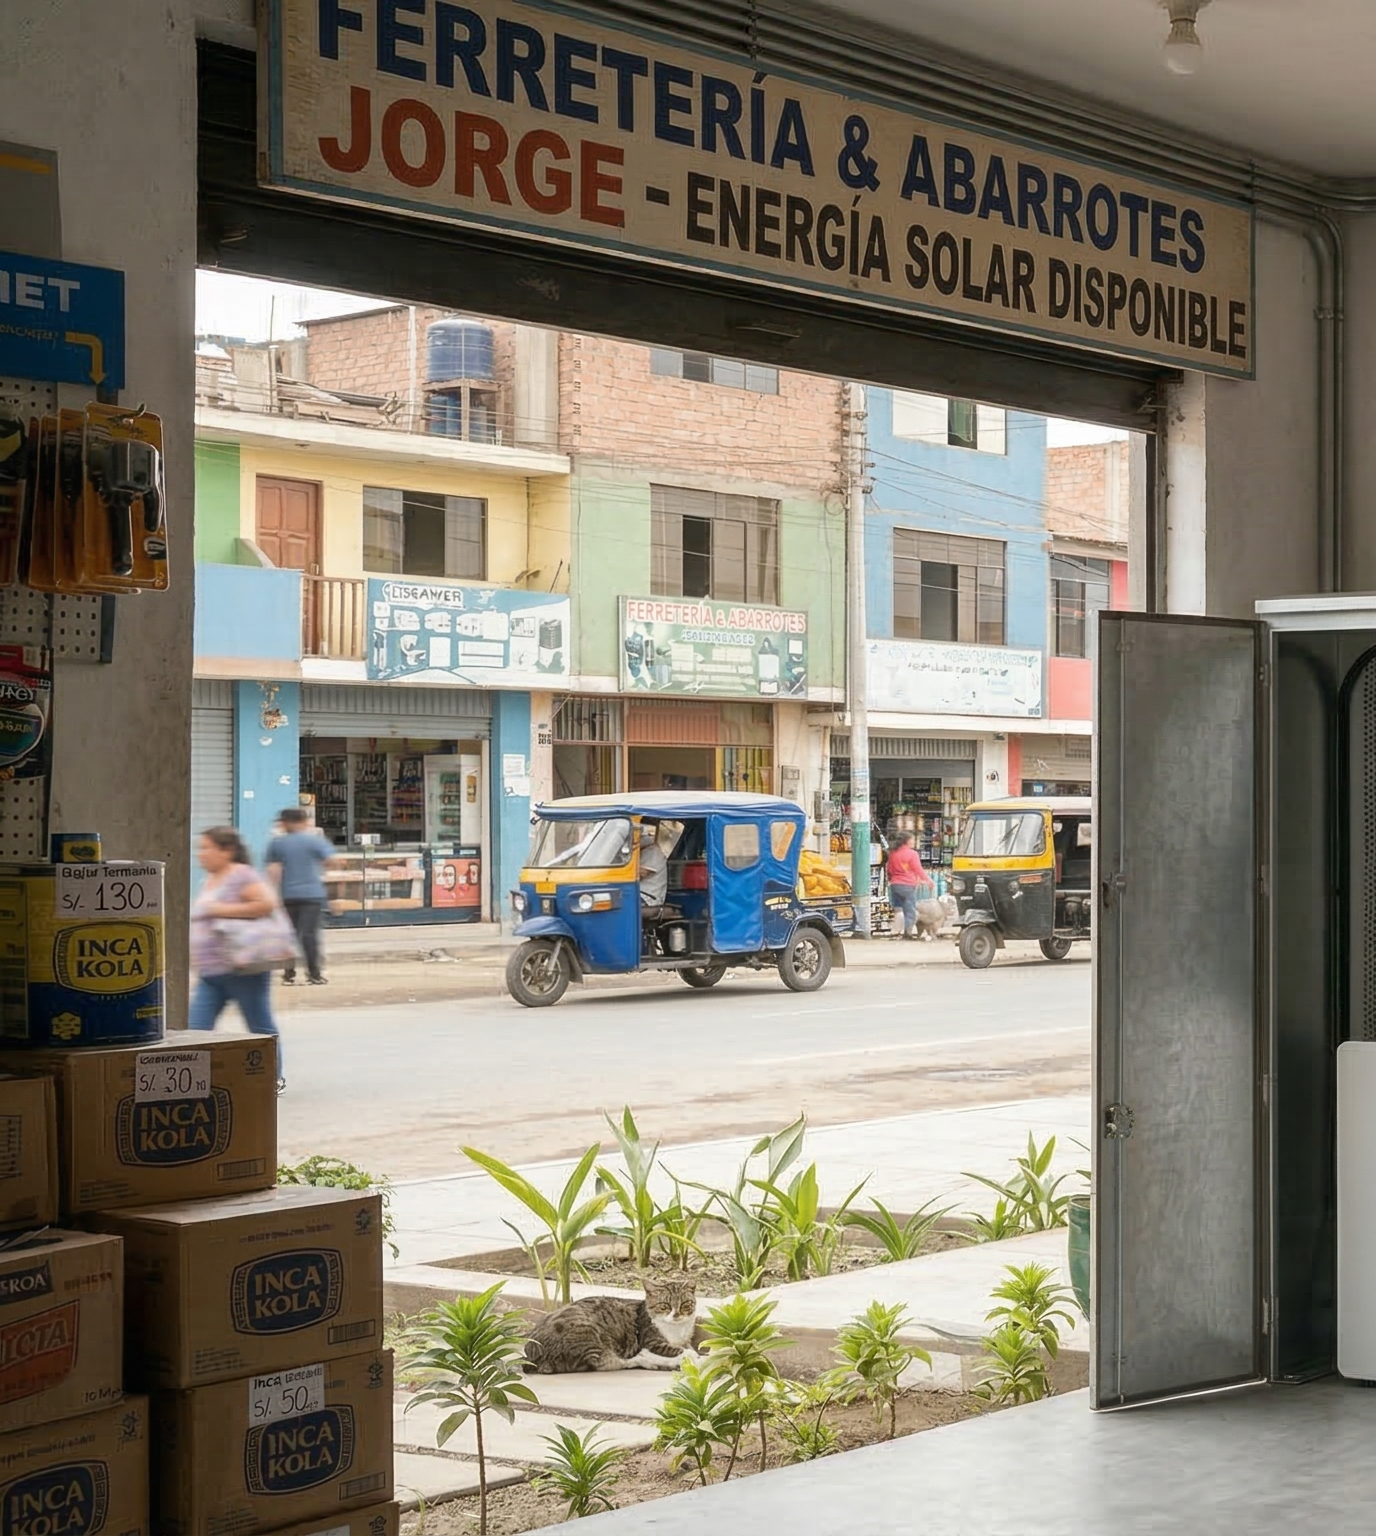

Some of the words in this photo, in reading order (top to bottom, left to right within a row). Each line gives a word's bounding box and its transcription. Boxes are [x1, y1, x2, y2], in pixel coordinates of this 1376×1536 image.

[318, 0, 815, 177] FERRETERÍA
[838, 115, 880, 193] &
[900, 134, 1206, 273] ABARROTES
[318, 85, 625, 228] JORGE
[687, 170, 892, 283] ENERGÍA
[904, 223, 1037, 313] SOLAR
[1048, 257, 1248, 358] DISPONIBLE
[728, 609, 806, 632] ABARROTES
[95, 882, 145, 911] 130
[78, 937, 143, 957] INCA
[77, 959, 144, 978] KOLA
[164, 1067, 192, 1093] 30
[139, 1102, 210, 1129] INCA
[139, 1126, 211, 1152] KOLA
[254, 1265, 322, 1296] INCA
[254, 1290, 322, 1319] KOLA
[254, 1376, 282, 1390] Inca
[281, 1385, 309, 1414] 50
[267, 1421, 335, 1458] INCA
[267, 1446, 334, 1479] KOLA
[11, 1480, 84, 1520] INCA
[11, 1506, 84, 1536] KOLA
